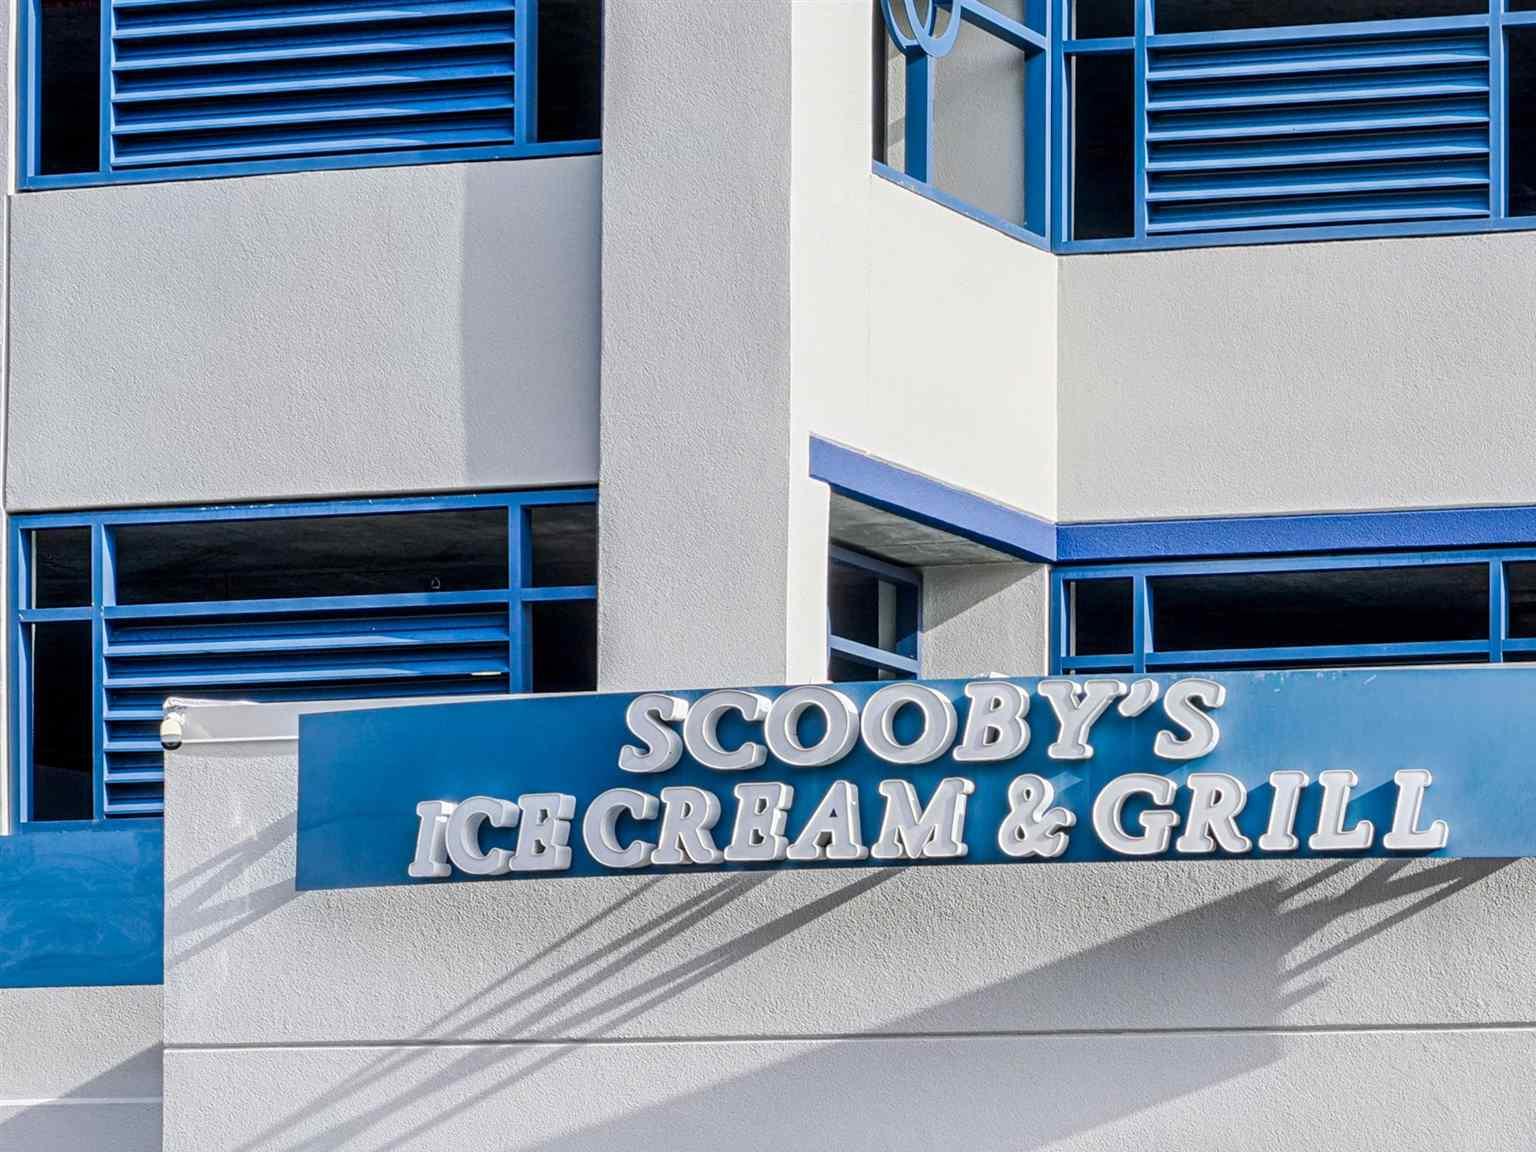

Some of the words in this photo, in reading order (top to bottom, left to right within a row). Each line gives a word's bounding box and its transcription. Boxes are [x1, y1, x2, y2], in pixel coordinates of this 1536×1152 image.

[618, 678, 1227, 774] SCOOBY'S
[408, 794, 574, 878] ICE
[583, 777, 974, 869] CREAM
[997, 773, 1078, 858] &
[1093, 768, 1450, 855] GRILL
